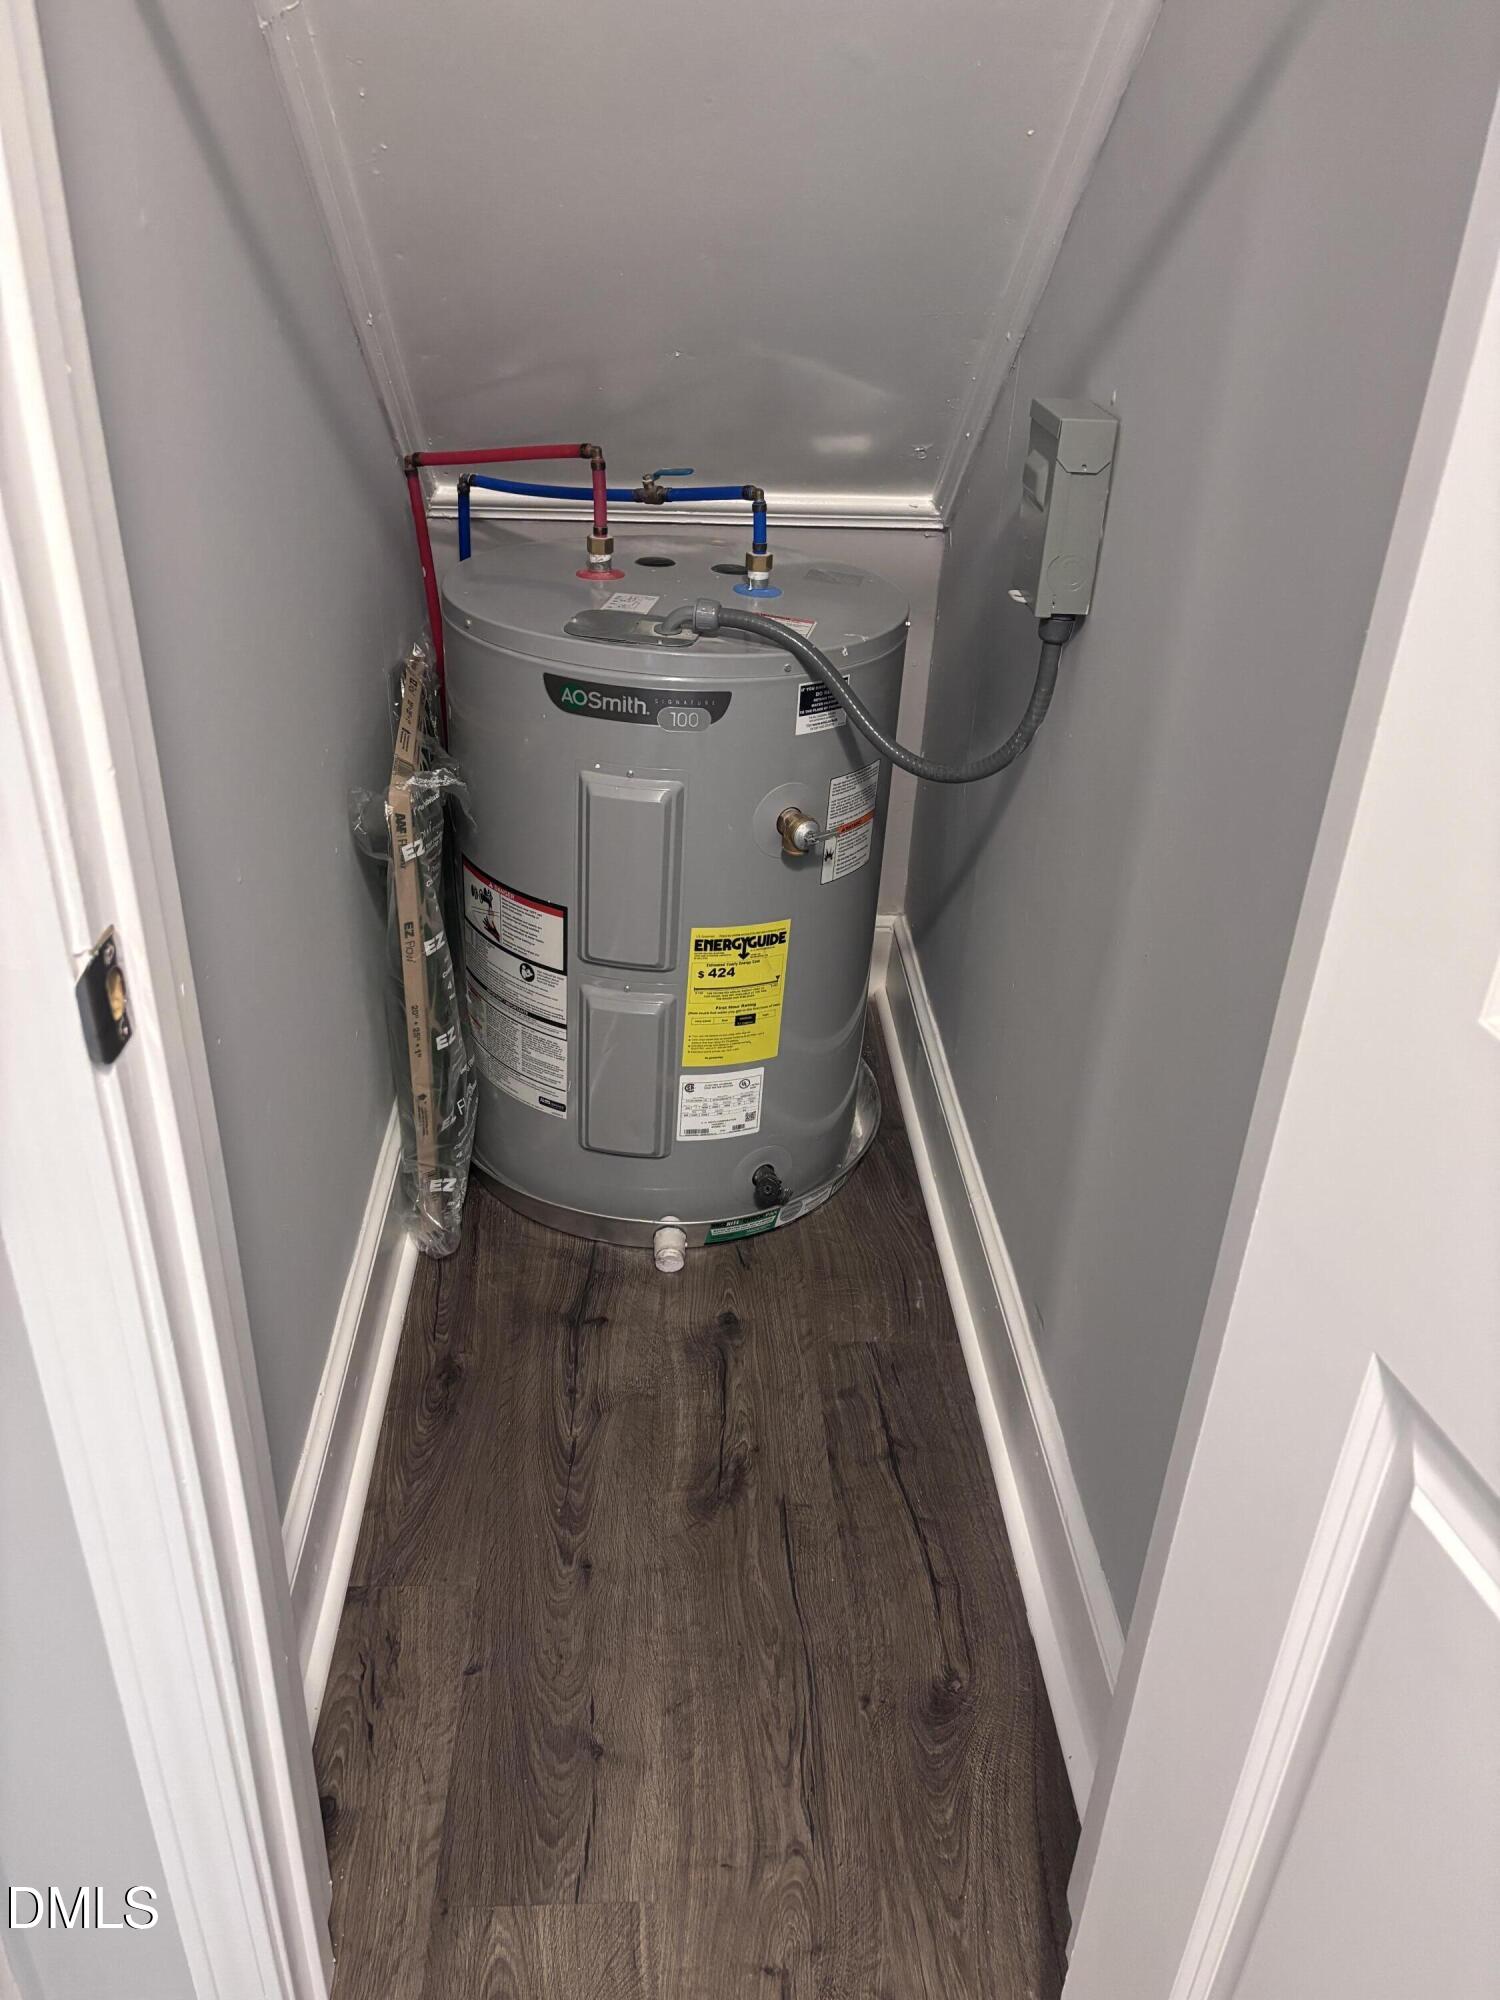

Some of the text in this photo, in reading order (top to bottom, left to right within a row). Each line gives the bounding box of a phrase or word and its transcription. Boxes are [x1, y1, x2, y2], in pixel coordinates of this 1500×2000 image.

[669, 712, 700, 728] 100
[401, 838, 426, 863] EZ
[403, 921, 415, 939] EZ
[423, 930, 446, 957] EZ
[694, 931, 787, 955] ENERGYGUIDE
[707, 967, 736, 979] 424
[436, 1025, 456, 1051] EZ
[429, 1177, 457, 1193] EZ
